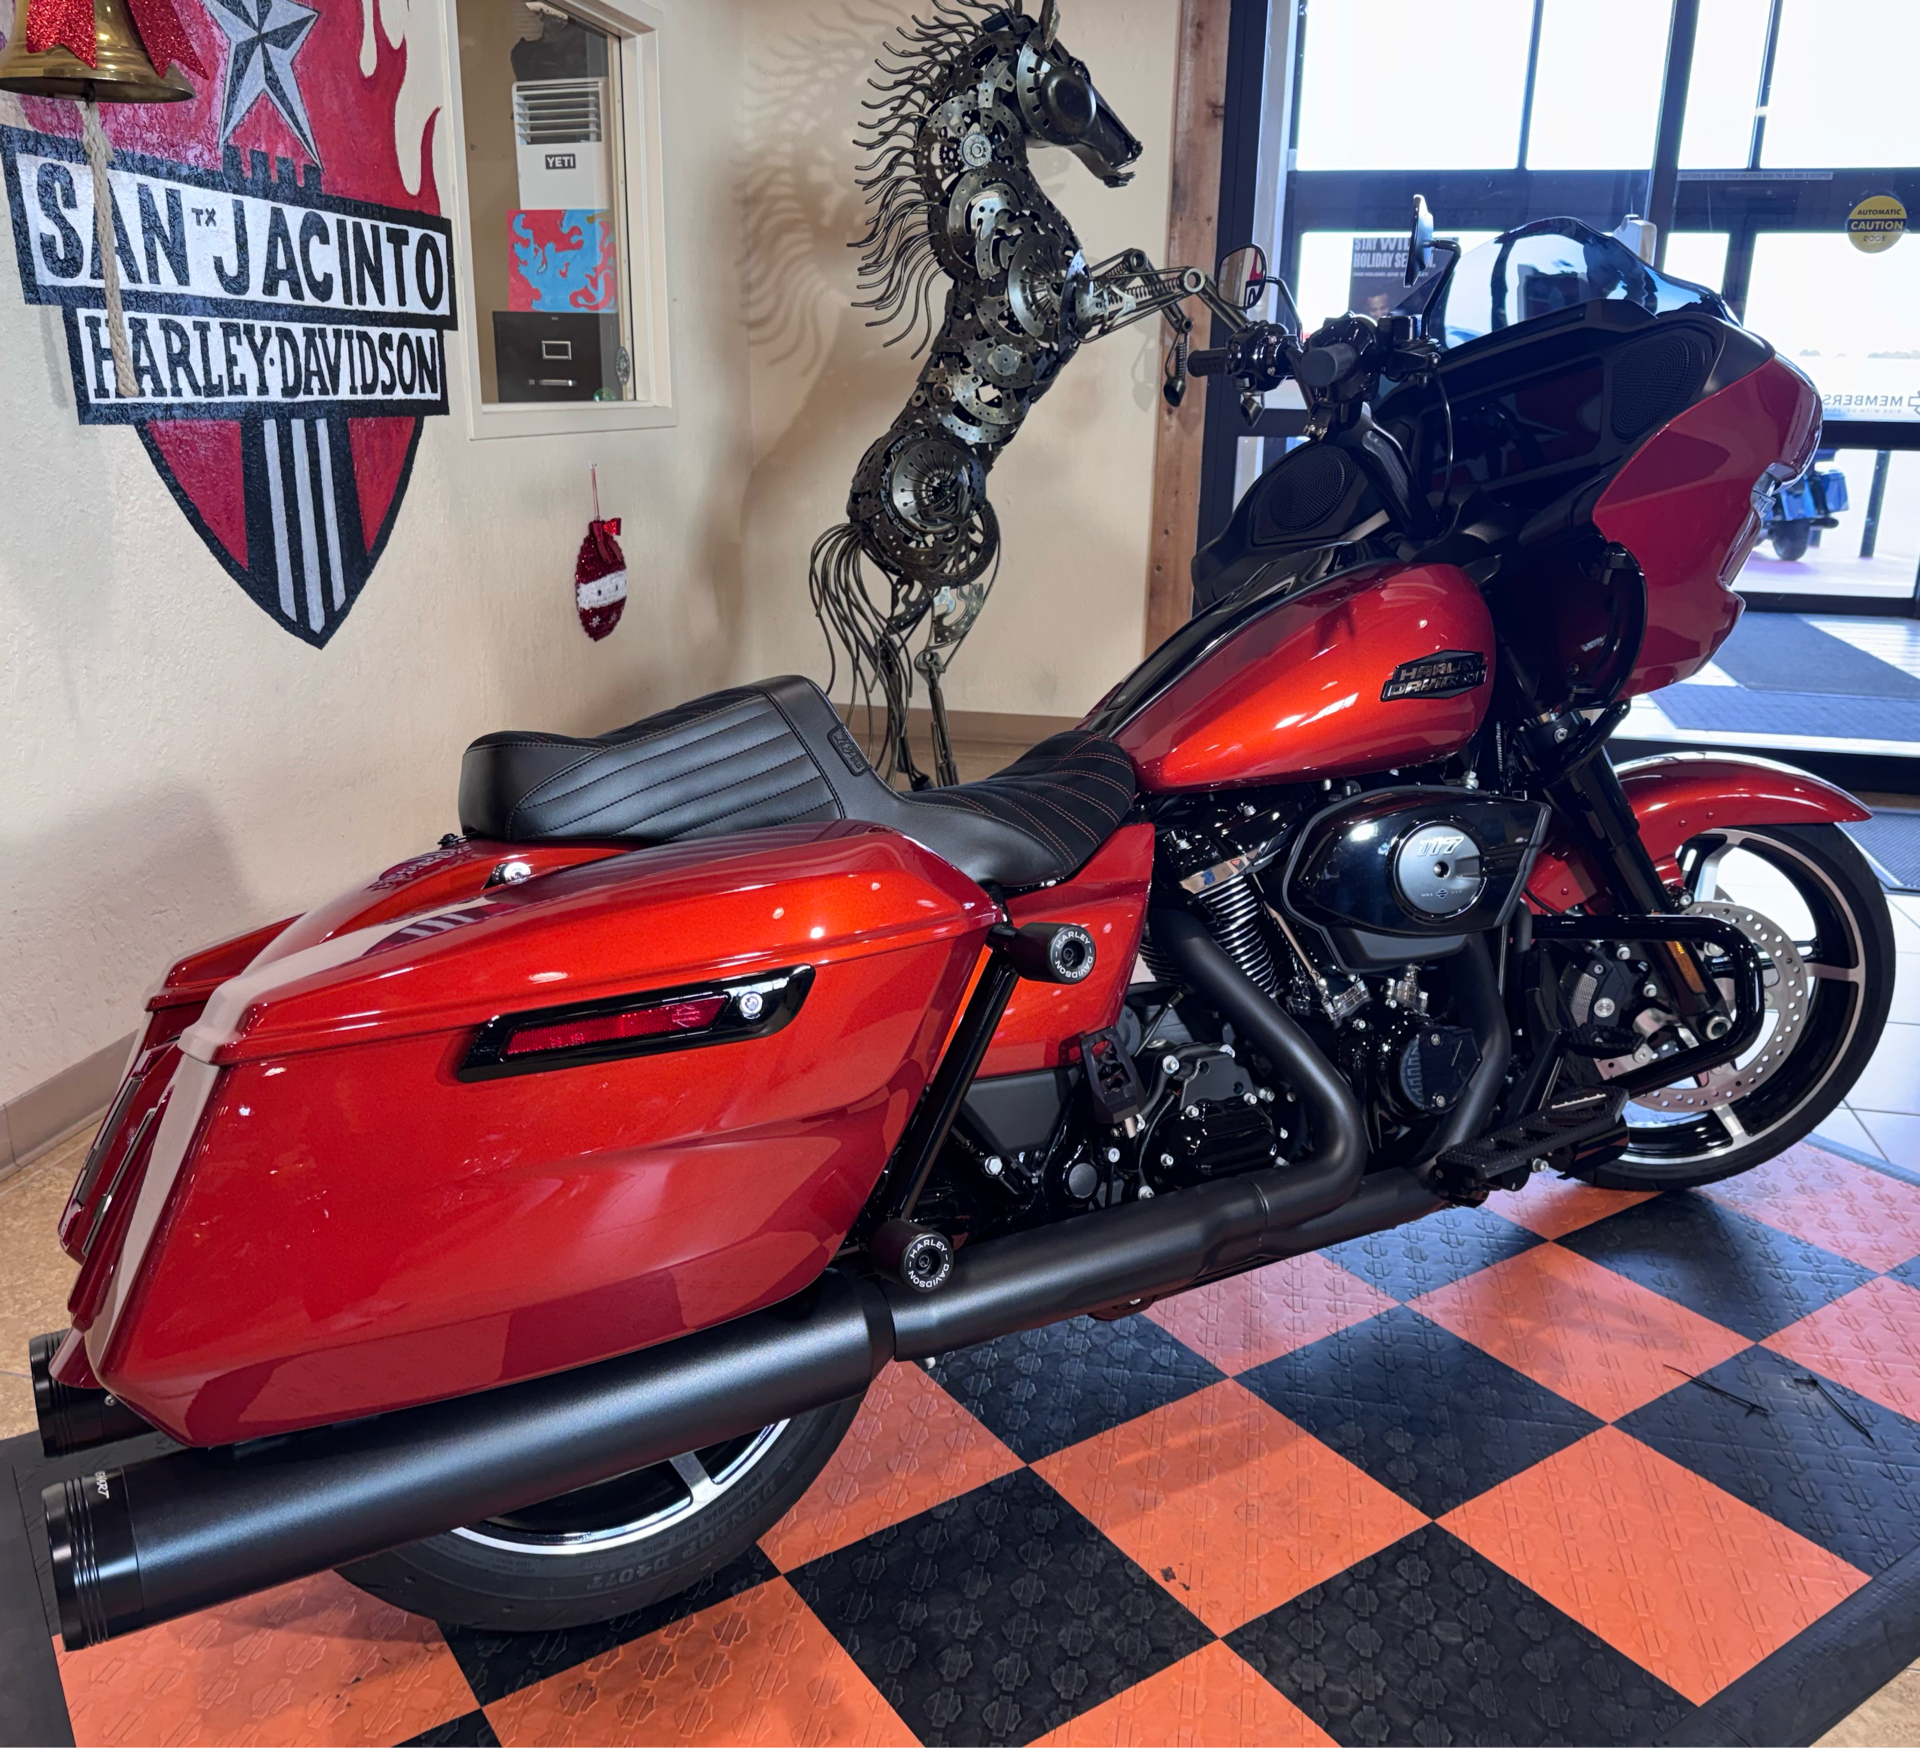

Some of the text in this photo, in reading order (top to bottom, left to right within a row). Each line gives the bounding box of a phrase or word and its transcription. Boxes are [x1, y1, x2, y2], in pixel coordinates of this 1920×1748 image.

[546, 156, 574, 168] YETI
[1857, 208, 1902, 216] AUTOMATIC
[1850, 220, 1904, 231] CAUTION
[37, 162, 443, 311] SAN TX JACINTO
[1354, 237, 1411, 251] STAY WIL
[1353, 252, 1394, 268] HOLIDAY
[1417, 835, 1464, 857] 117
[682, 1478, 779, 1559] DUNLOP
